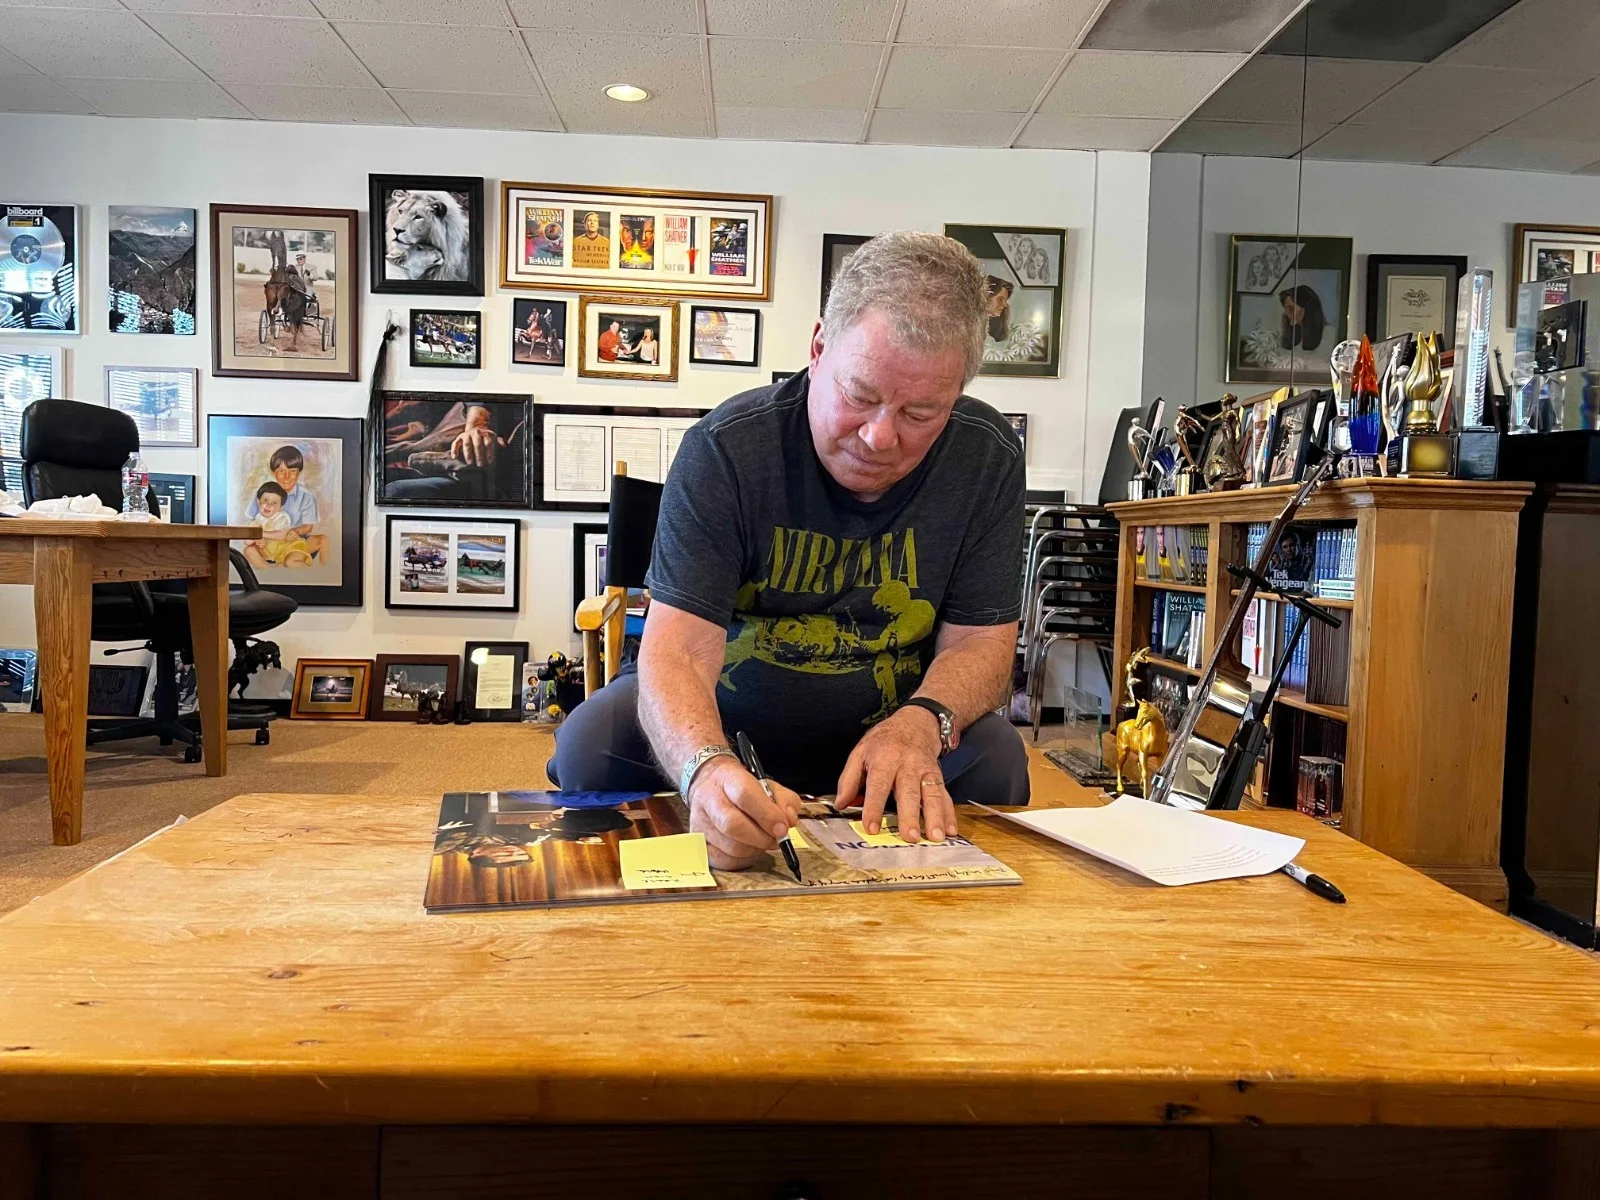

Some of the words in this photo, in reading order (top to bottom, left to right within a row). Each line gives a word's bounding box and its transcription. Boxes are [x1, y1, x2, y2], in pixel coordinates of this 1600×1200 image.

[7, 206, 43, 215] billboard
[528, 208, 562, 216] WILLIAM
[665, 217, 688, 229] WILLIAM
[665, 230, 688, 243] SHATNER
[573, 244, 591, 252] STAR
[593, 245, 610, 253] TREK
[528, 256, 563, 266] TekWar
[1272, 569, 1289, 580] Tek
[1264, 576, 1306, 590] Vengean
[1170, 595, 1202, 604] WILLIA
